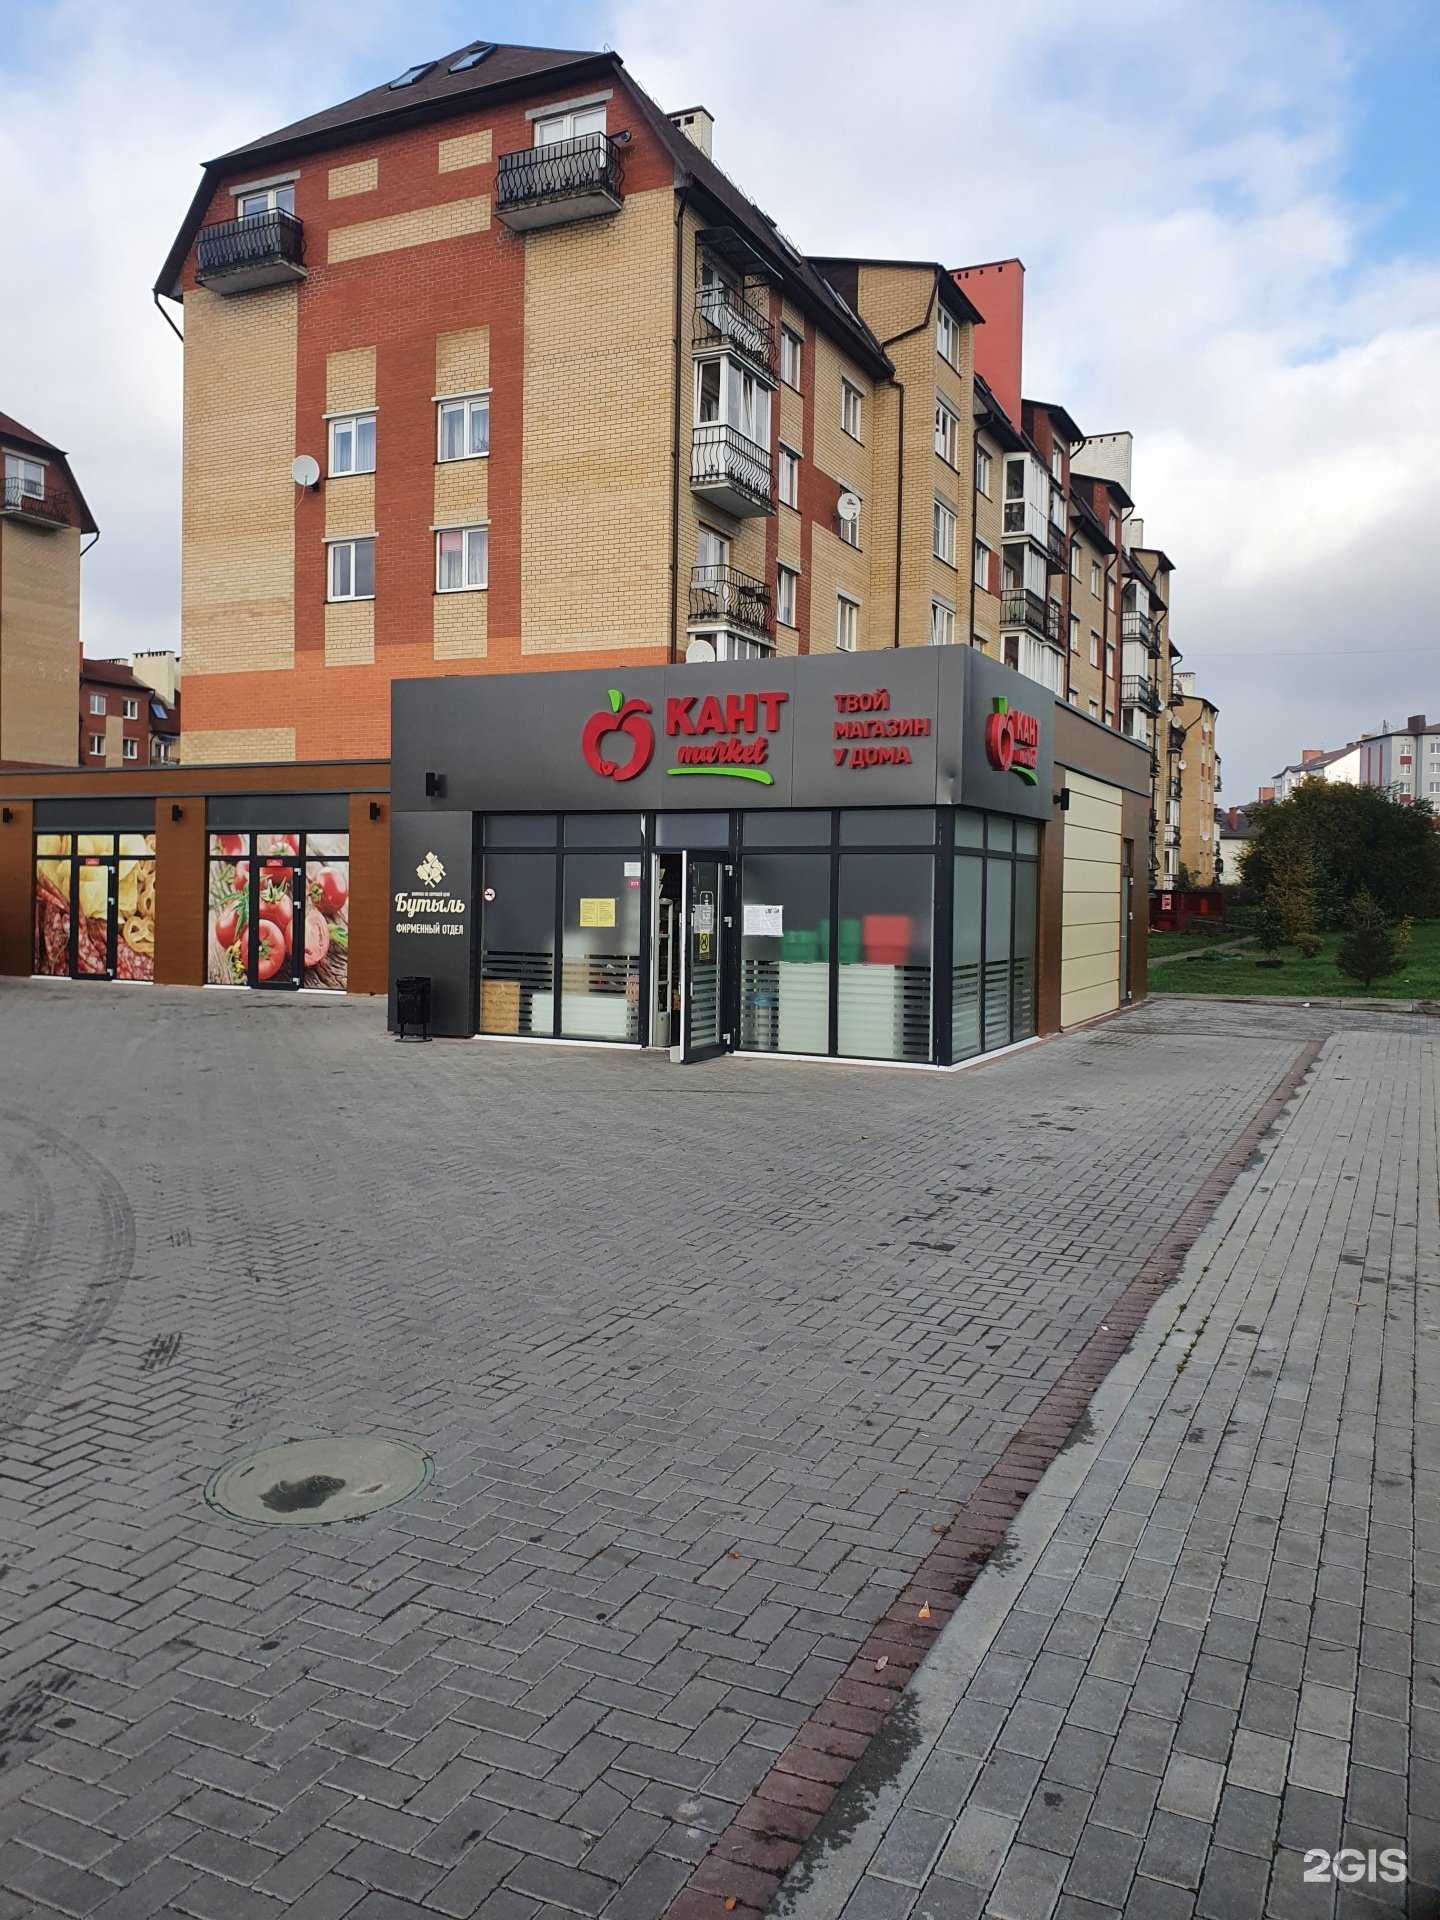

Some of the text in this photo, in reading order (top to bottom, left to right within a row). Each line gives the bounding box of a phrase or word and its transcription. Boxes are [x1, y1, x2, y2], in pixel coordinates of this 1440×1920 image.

[666, 691, 789, 735] КАНТ
[834, 688, 890, 713] ТВОЙ
[833, 717, 931, 739] МАГАЗИН
[677, 736, 769, 764] market
[833, 745, 913, 769] У ДОМА
[394, 892, 466, 918] Бутыль
[396, 922, 464, 936] ФИРМЕННЫЙ ОТДЕЛ
